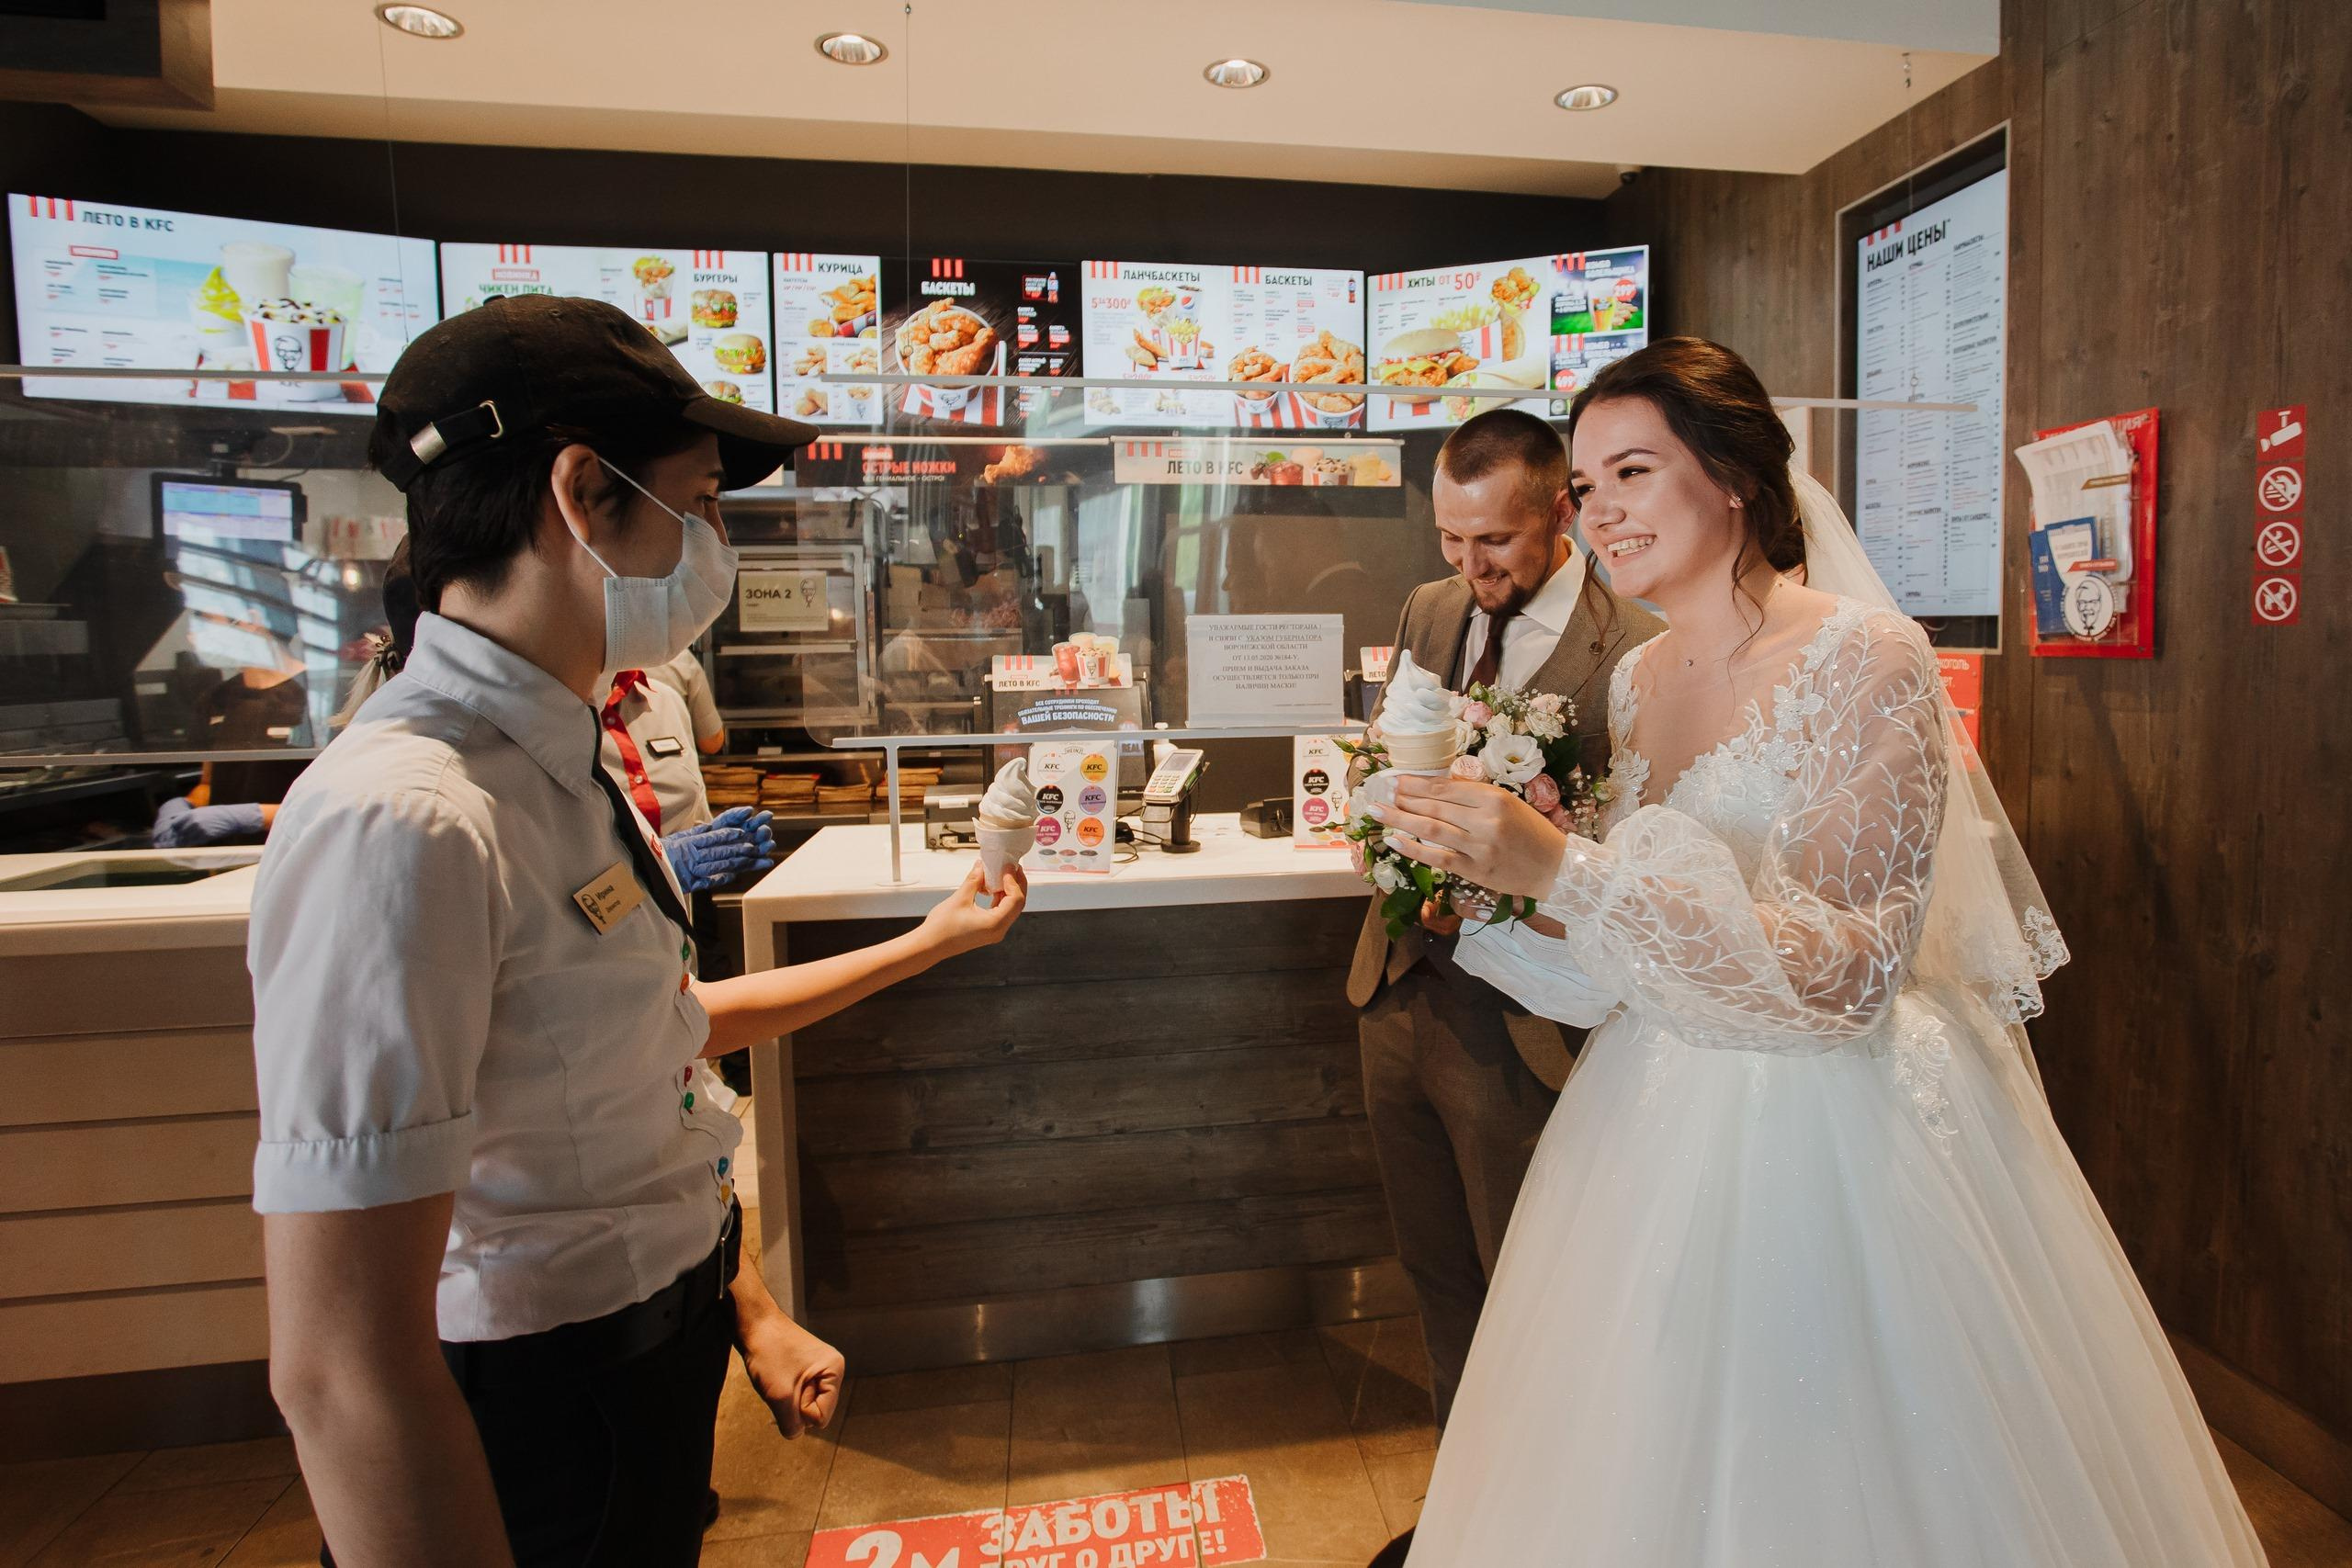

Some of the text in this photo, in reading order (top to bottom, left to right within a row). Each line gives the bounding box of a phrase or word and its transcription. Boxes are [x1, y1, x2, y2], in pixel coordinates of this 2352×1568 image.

[83, 211, 175, 231] ЛЕТО В KFC
[1867, 240, 1904, 272] НАШИ
[818, 263, 863, 275] КУРИЦА
[694, 273, 738, 284] БУРГЕРЫ
[1123, 270, 1201, 282] ЛАНЧБАСКЕТЫ
[1265, 275, 1312, 286] БАСКЕТЫ
[1407, 276, 1435, 288] ХИТЫ
[1439, 275, 1451, 286] ОТ
[479, 284, 554, 295] ЧИКЕН ПИТА
[921, 280, 976, 296] БАСКЕТЫ
[862, 461, 956, 474] ОСТРЫЕ НОЖКИ
[1167, 461, 1202, 475] ЛЕТО
[1206, 462, 1214, 474] В
[745, 589, 792, 599] ЗОНА 2
[999, 680, 1017, 688] ЛЕТО
[1021, 711, 1114, 725] ВАШЕЙ БЕЗОПАСНОСТИ
[979, 1481, 1221, 1558] ЗАБОТЫ
[1109, 1529, 1227, 1568] ДРУГЕ!
